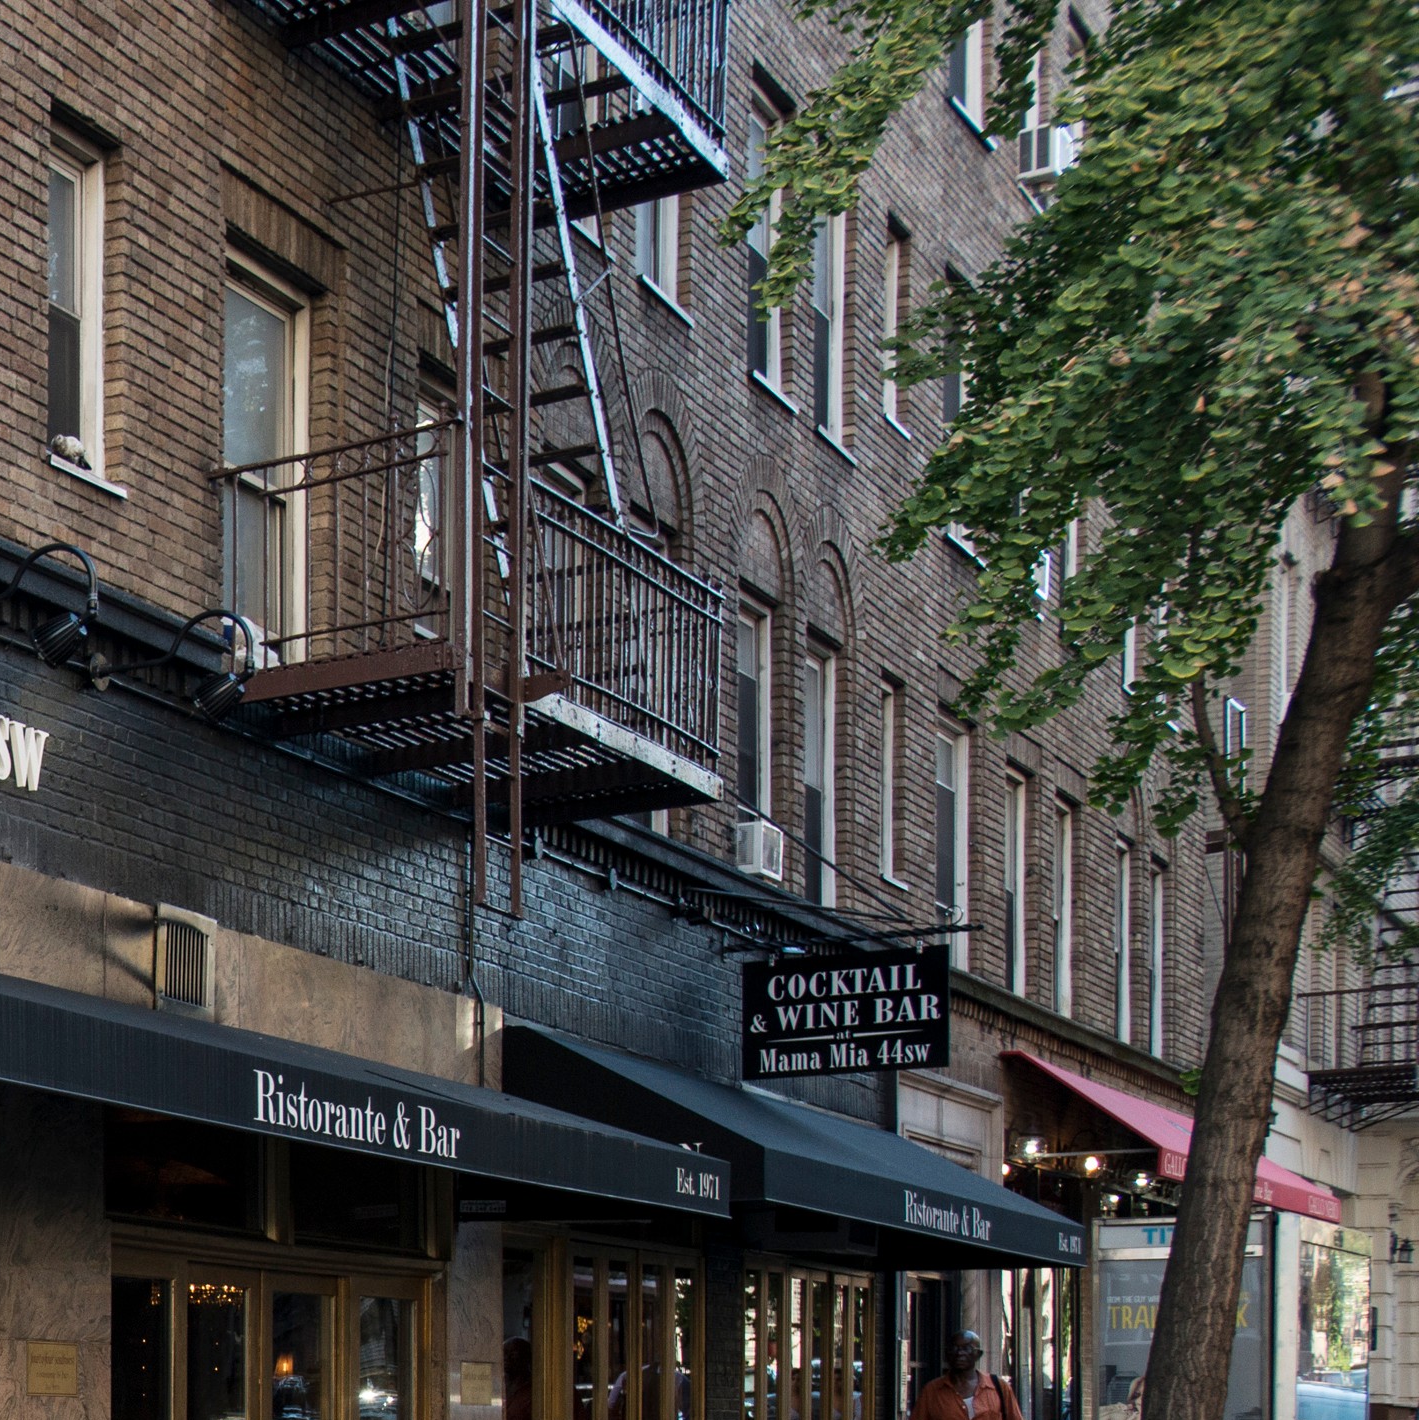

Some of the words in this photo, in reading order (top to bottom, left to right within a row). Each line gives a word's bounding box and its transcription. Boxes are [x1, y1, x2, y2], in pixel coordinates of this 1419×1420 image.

[767, 963, 922, 1001] COCKTAIL
[749, 1013, 768, 1034] &
[776, 1000, 860, 1032] WINE
[873, 994, 941, 1025] BAR
[835, 1029, 852, 1041] at
[759, 1048, 822, 1074] Mama
[829, 1043, 869, 1069] Mia
[253, 1068, 386, 1145] Ristorante
[393, 1101, 411, 1151] &
[418, 1105, 461, 1159] Bar
[676, 1166, 695, 1196] Est.
[699, 1172, 720, 1200] 1971
[903, 1189, 959, 1235] Ristorante
[972, 1207, 991, 1242] Bar
